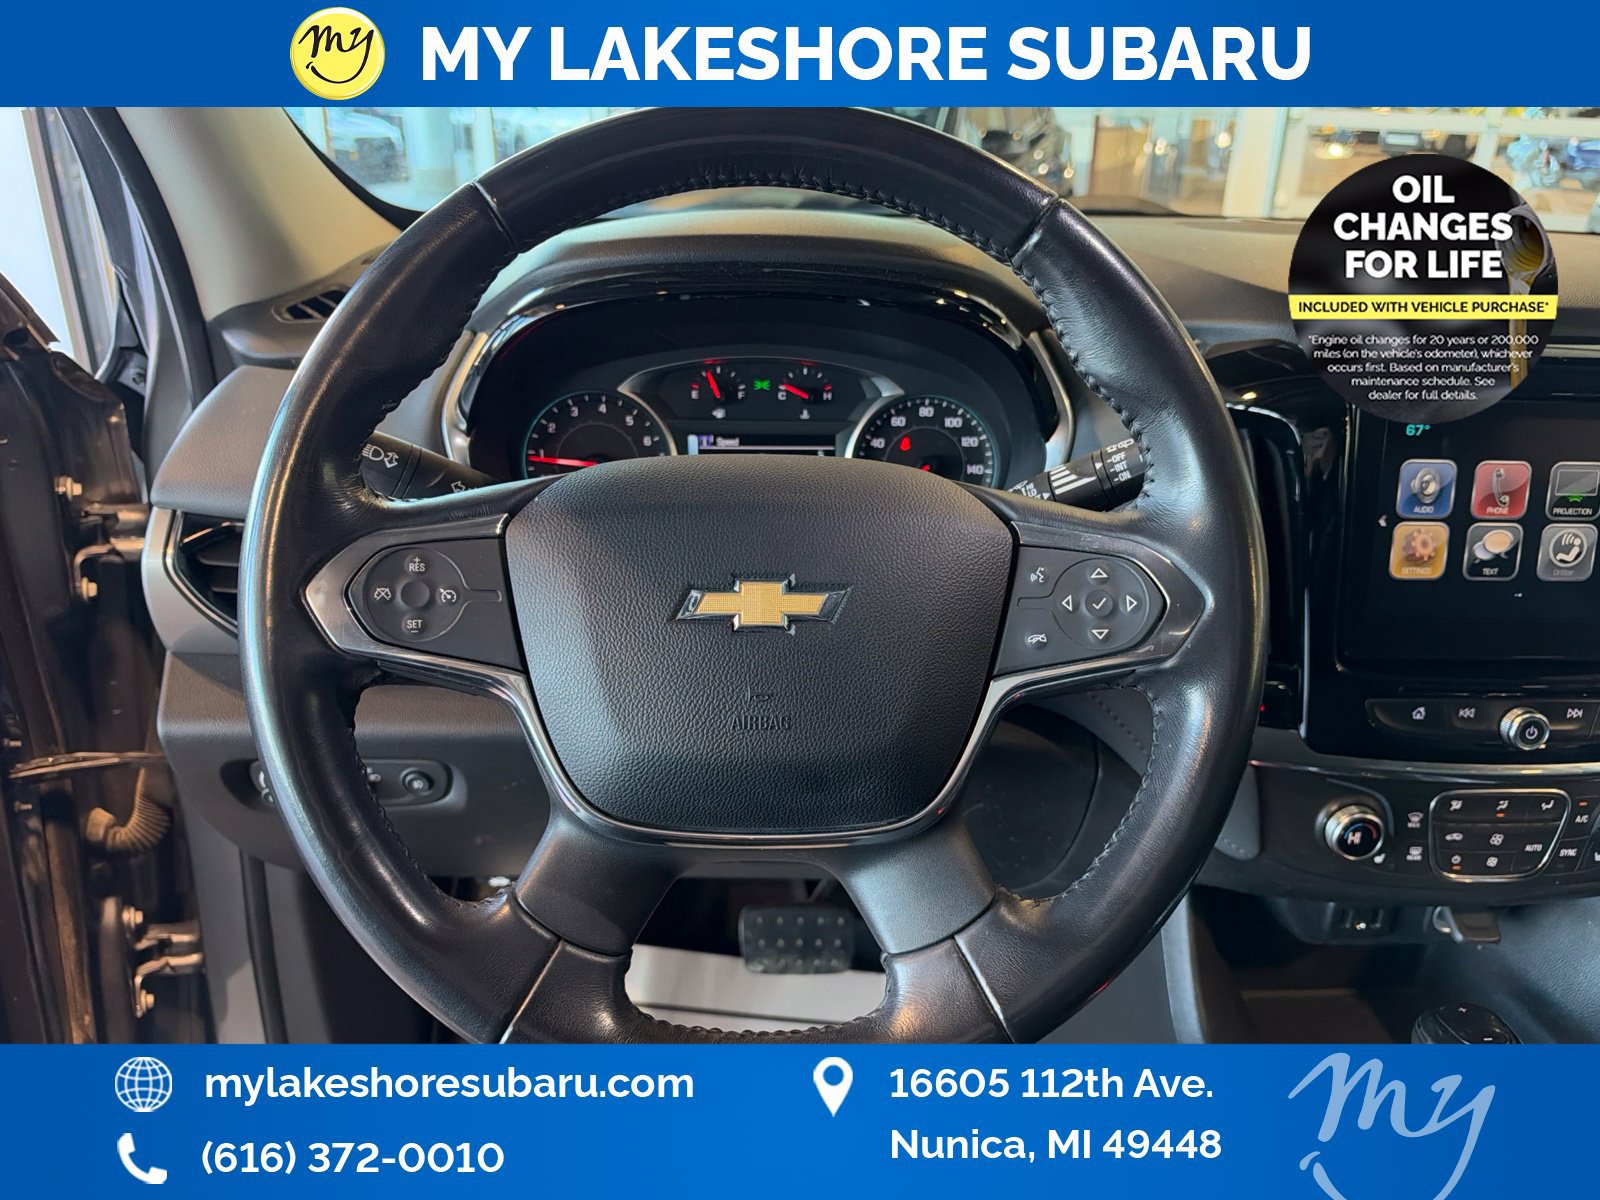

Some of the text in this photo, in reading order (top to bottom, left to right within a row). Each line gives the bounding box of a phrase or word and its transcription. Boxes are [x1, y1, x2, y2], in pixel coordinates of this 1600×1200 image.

[691, 390, 699, 399] E
[737, 390, 745, 399] F
[777, 391, 787, 400] C
[823, 391, 832, 400] H
[570, 406, 579, 417] 3
[597, 403, 607, 414] 4
[918, 406, 935, 417] 80
[890, 416, 906, 427] 60
[944, 417, 963, 428] 100
[547, 422, 556, 433] 2
[870, 437, 886, 448] 40
[960, 436, 979, 447] 120
[1111, 452, 1126, 463] OFF
[966, 464, 985, 475] 140
[1115, 461, 1128, 472] INT
[1119, 471, 1131, 482] ON
[1413, 505, 1435, 514] AUDIO
[1485, 507, 1510, 516] PHONE
[1552, 507, 1593, 517] PROJECTION
[408, 562, 426, 573] RES
[1481, 567, 1500, 576] TEXT
[406, 619, 423, 629] SET
[730, 714, 790, 731] AIRBAG
[1574, 814, 1589, 824] A/C
[1347, 831, 1361, 845] HI
[1524, 843, 1543, 852] AUTO
[1558, 848, 1578, 857] SYNC
